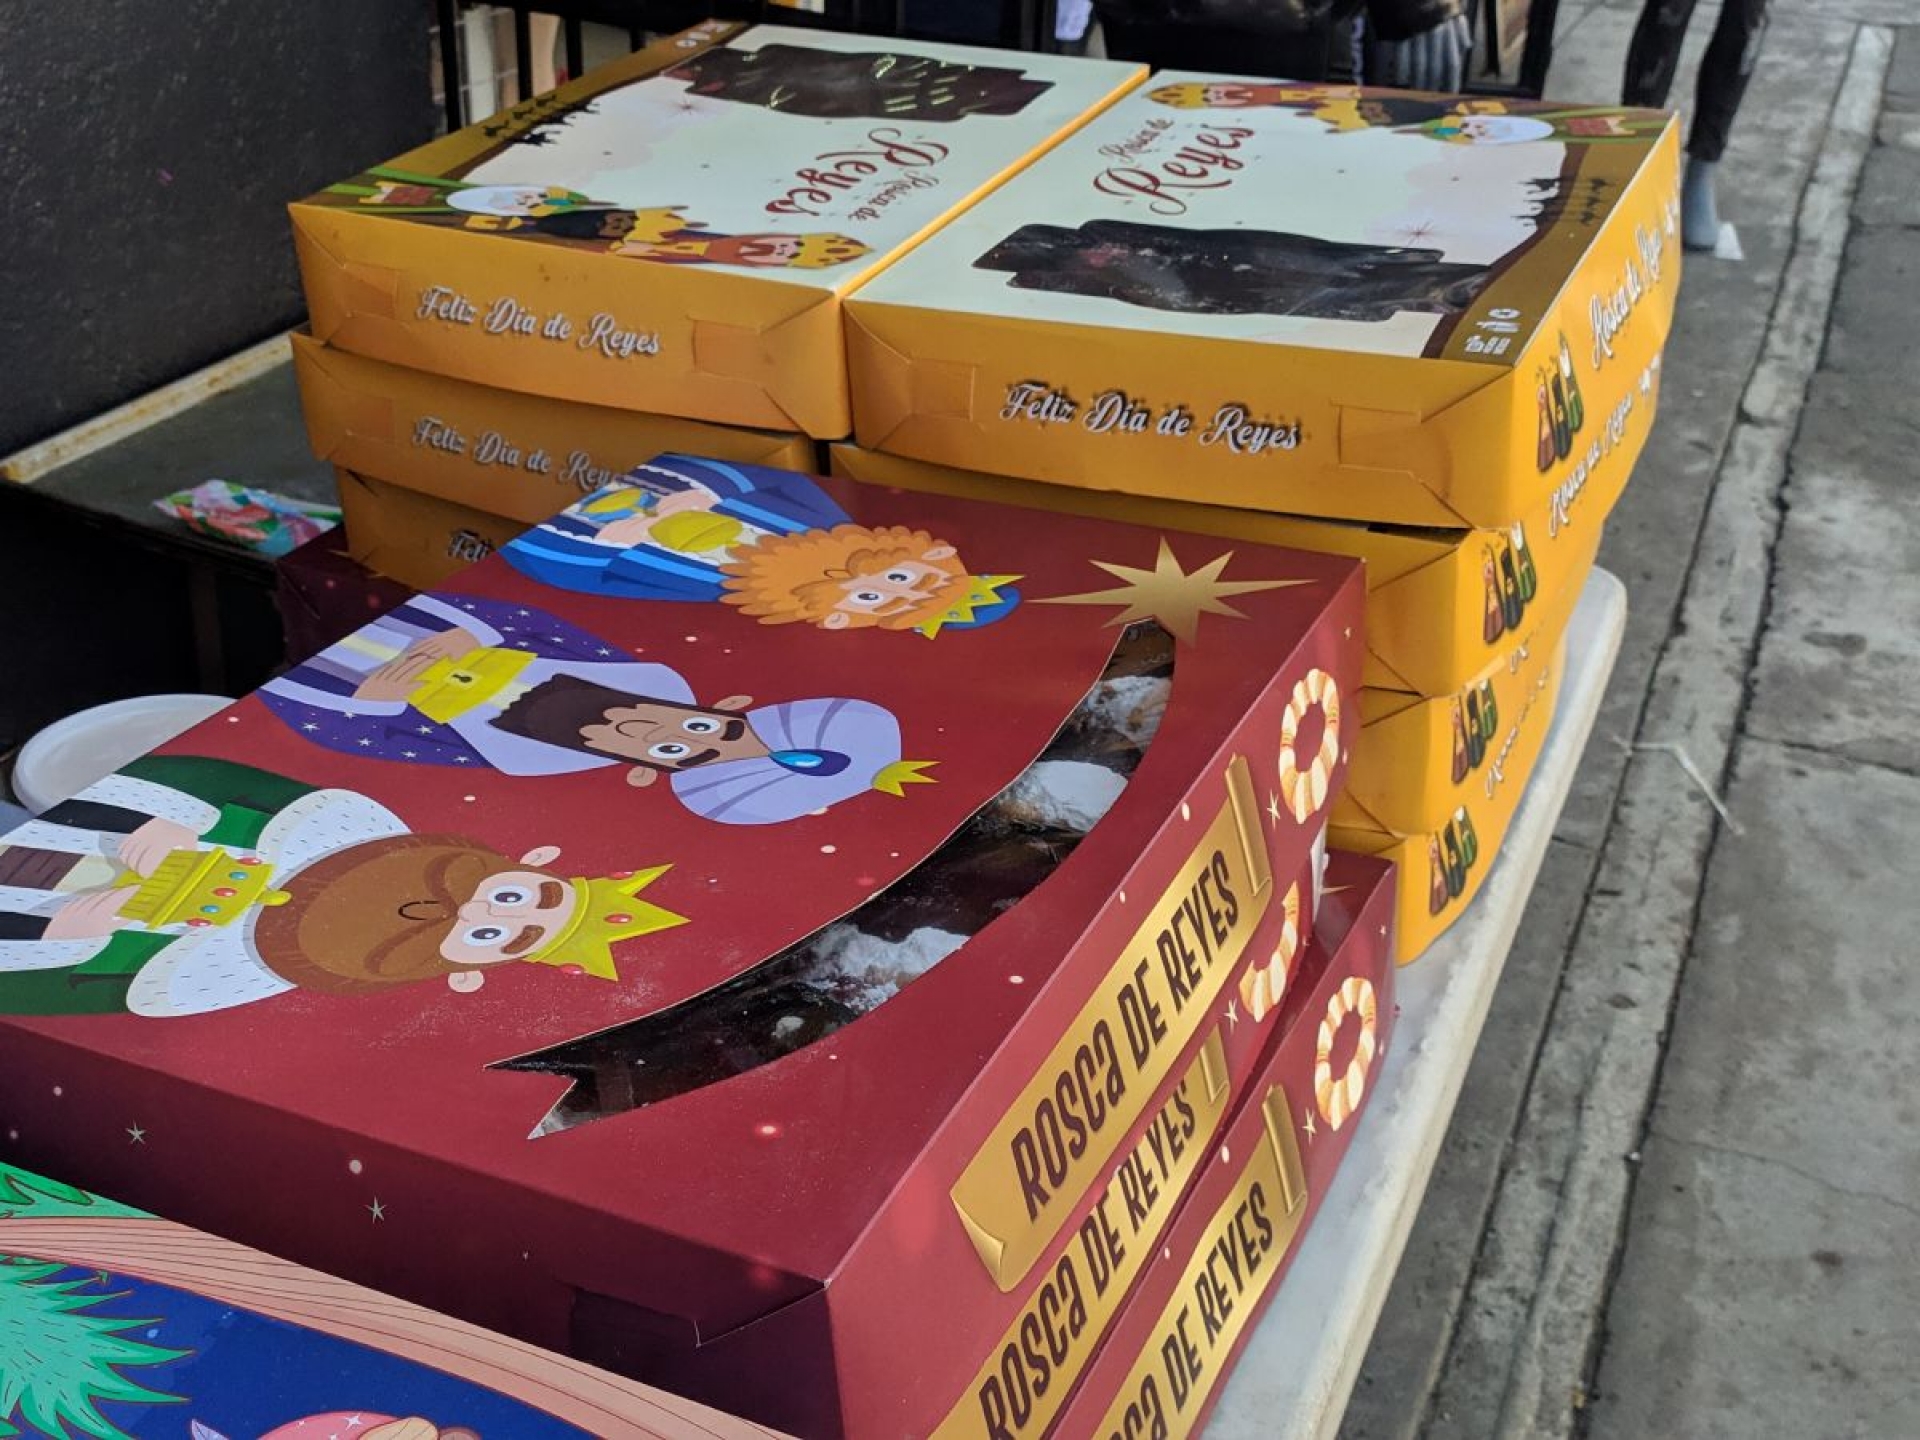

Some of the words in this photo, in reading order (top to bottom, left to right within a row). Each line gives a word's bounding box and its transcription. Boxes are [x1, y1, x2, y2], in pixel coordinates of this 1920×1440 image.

[765, 127, 949, 217] Reyes
[1093, 123, 1255, 215] Reyes
[416, 284, 479, 324] Feliz
[541, 313, 574, 341] de
[577, 312, 662, 358] Reyes
[411, 415, 469, 453] Feliz
[525, 446, 553, 475] de
[999, 381, 1077, 424] Feliz
[1155, 407, 1193, 438] de
[1198, 403, 1299, 455] Reyes
[1117, 956, 1169, 1071] DE
[1156, 850, 1239, 1017] REYES
[1080, 1190, 1126, 1300] DE
[1117, 1078, 1196, 1235] REYES
[1161, 1304, 1203, 1415] DE
[1194, 1180, 1273, 1350] REYES
